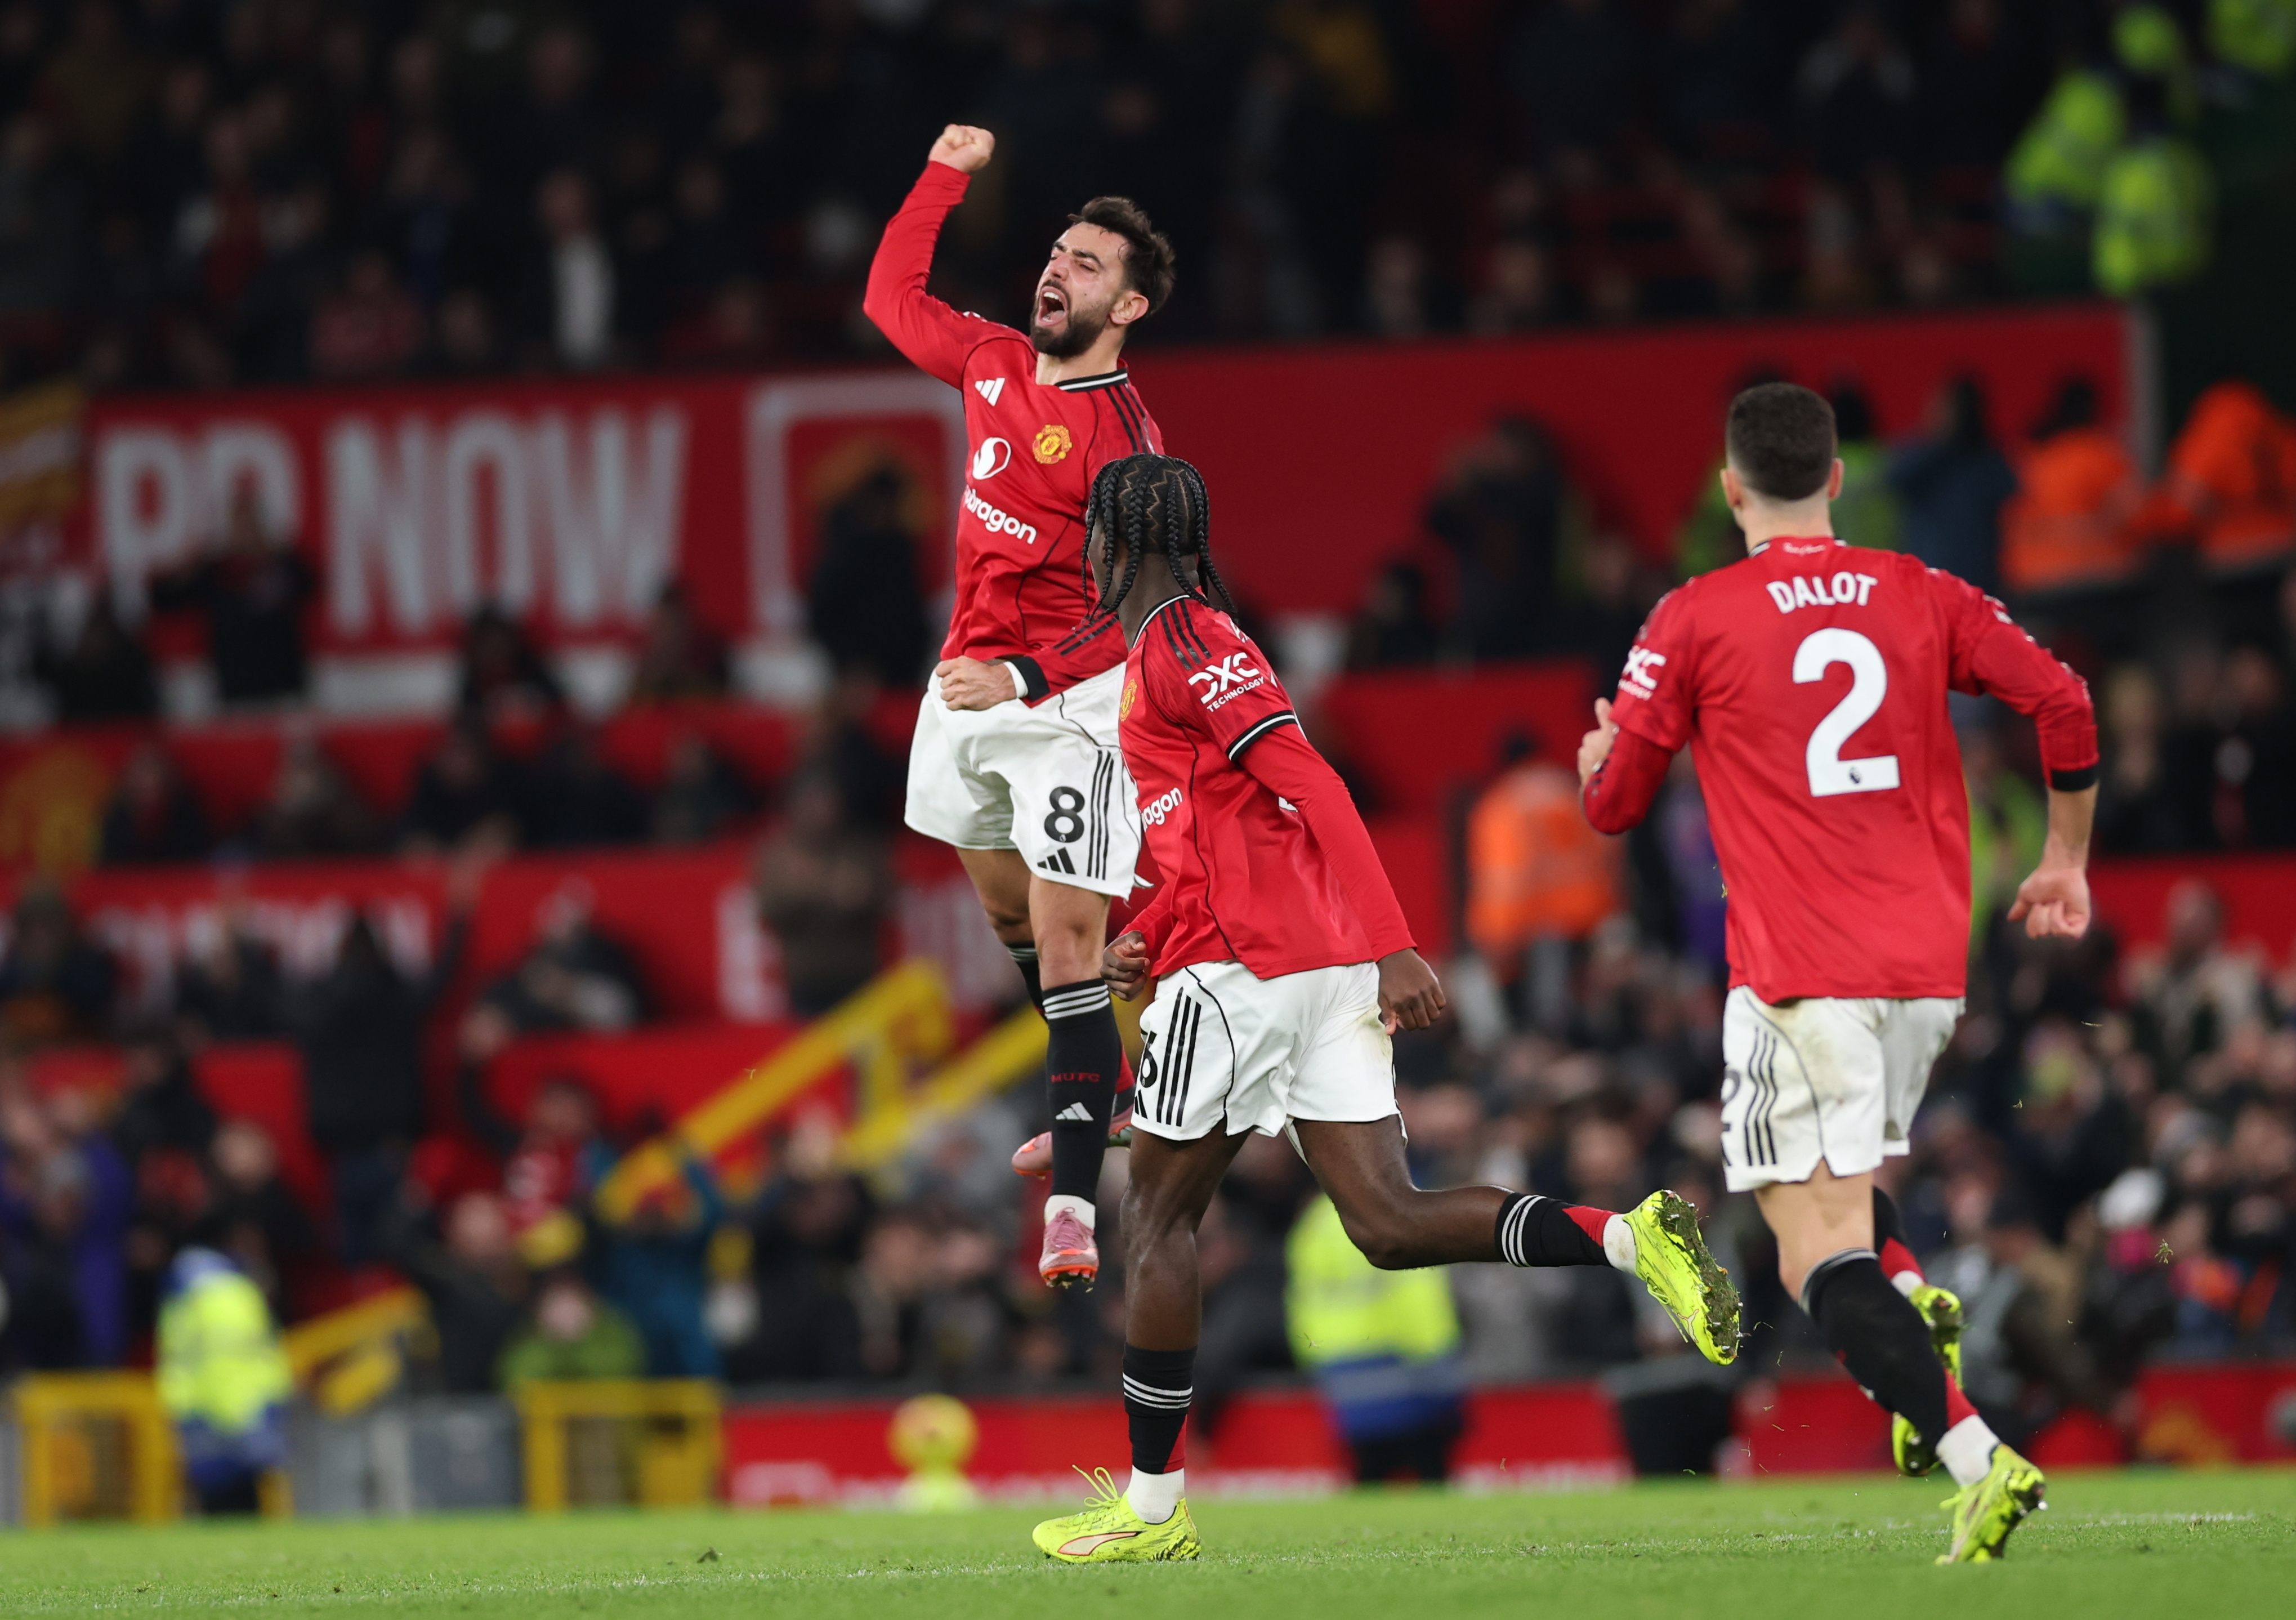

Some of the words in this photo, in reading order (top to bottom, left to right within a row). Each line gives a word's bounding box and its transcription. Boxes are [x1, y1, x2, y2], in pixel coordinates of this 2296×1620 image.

[327, 408, 685, 630] NOW
[1766, 571, 1878, 614] DALOT
[1187, 651, 1260, 704] DXC
[1207, 676, 1265, 712] TECHNOLOGY
[1793, 627, 1900, 797] 2
[1044, 786, 1085, 843] 8
